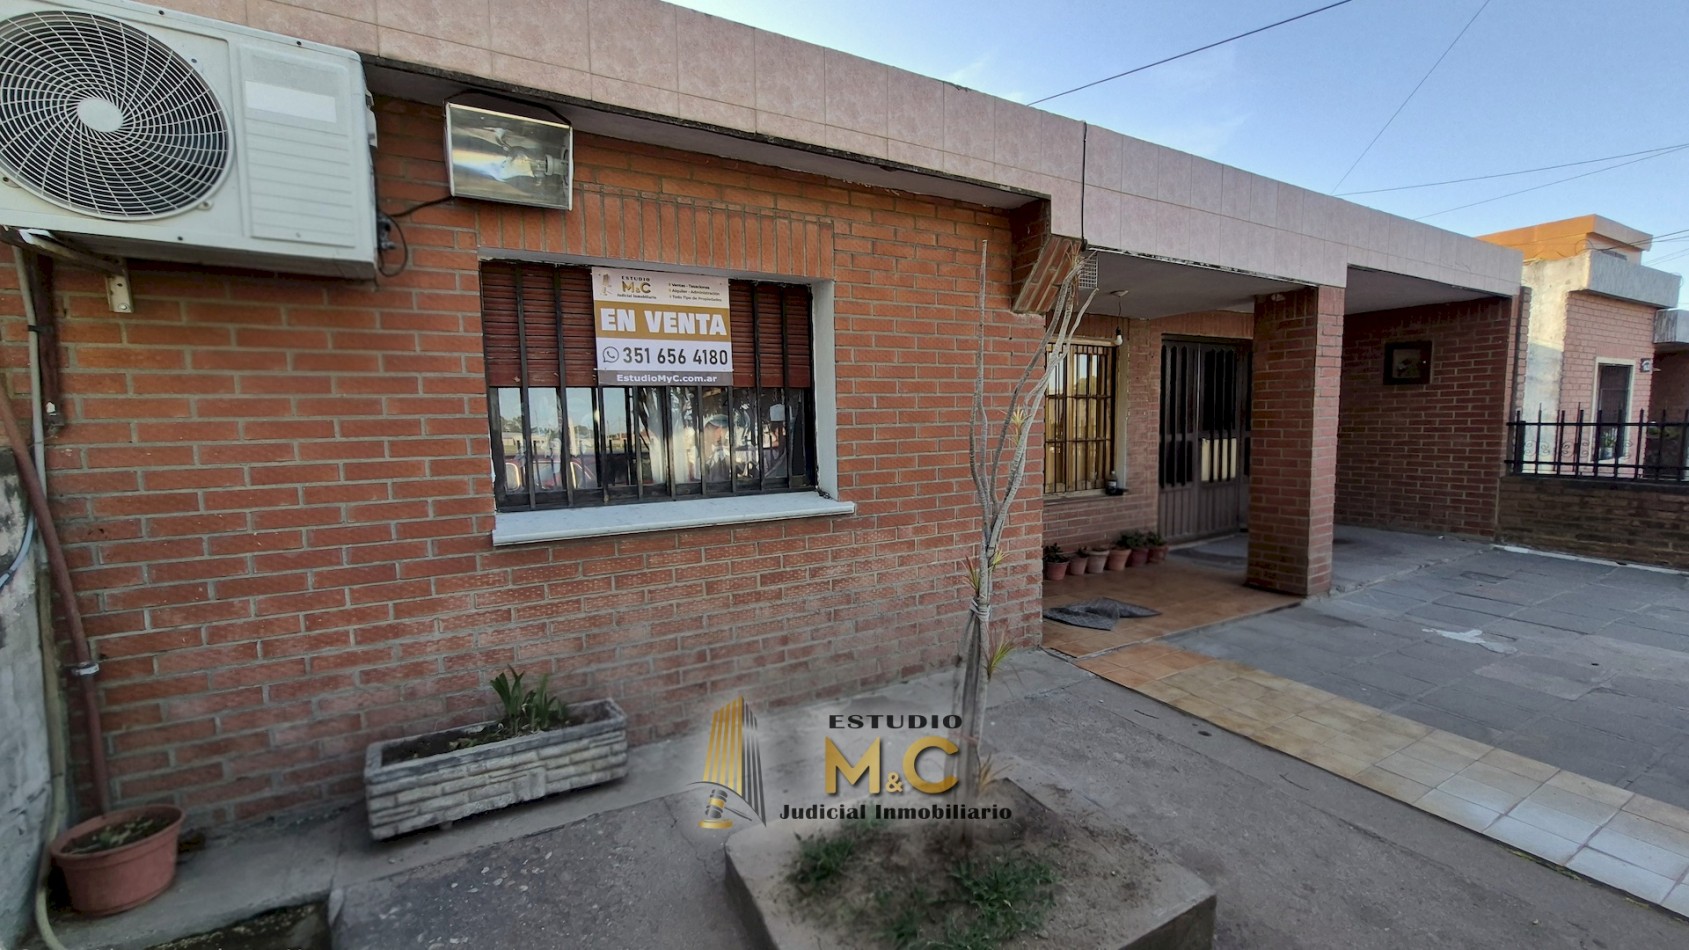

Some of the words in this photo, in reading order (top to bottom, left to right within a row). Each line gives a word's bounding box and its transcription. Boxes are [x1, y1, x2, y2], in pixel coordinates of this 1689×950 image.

[621, 281, 651, 293] M&C
[600, 308, 636, 332] EN
[644, 310, 727, 336] VENTA
[622, 346, 650, 364] 351
[657, 348, 686, 365] 656
[693, 349, 728, 365] 4180
[616, 374, 717, 383] EstudioMyC.com.ar
